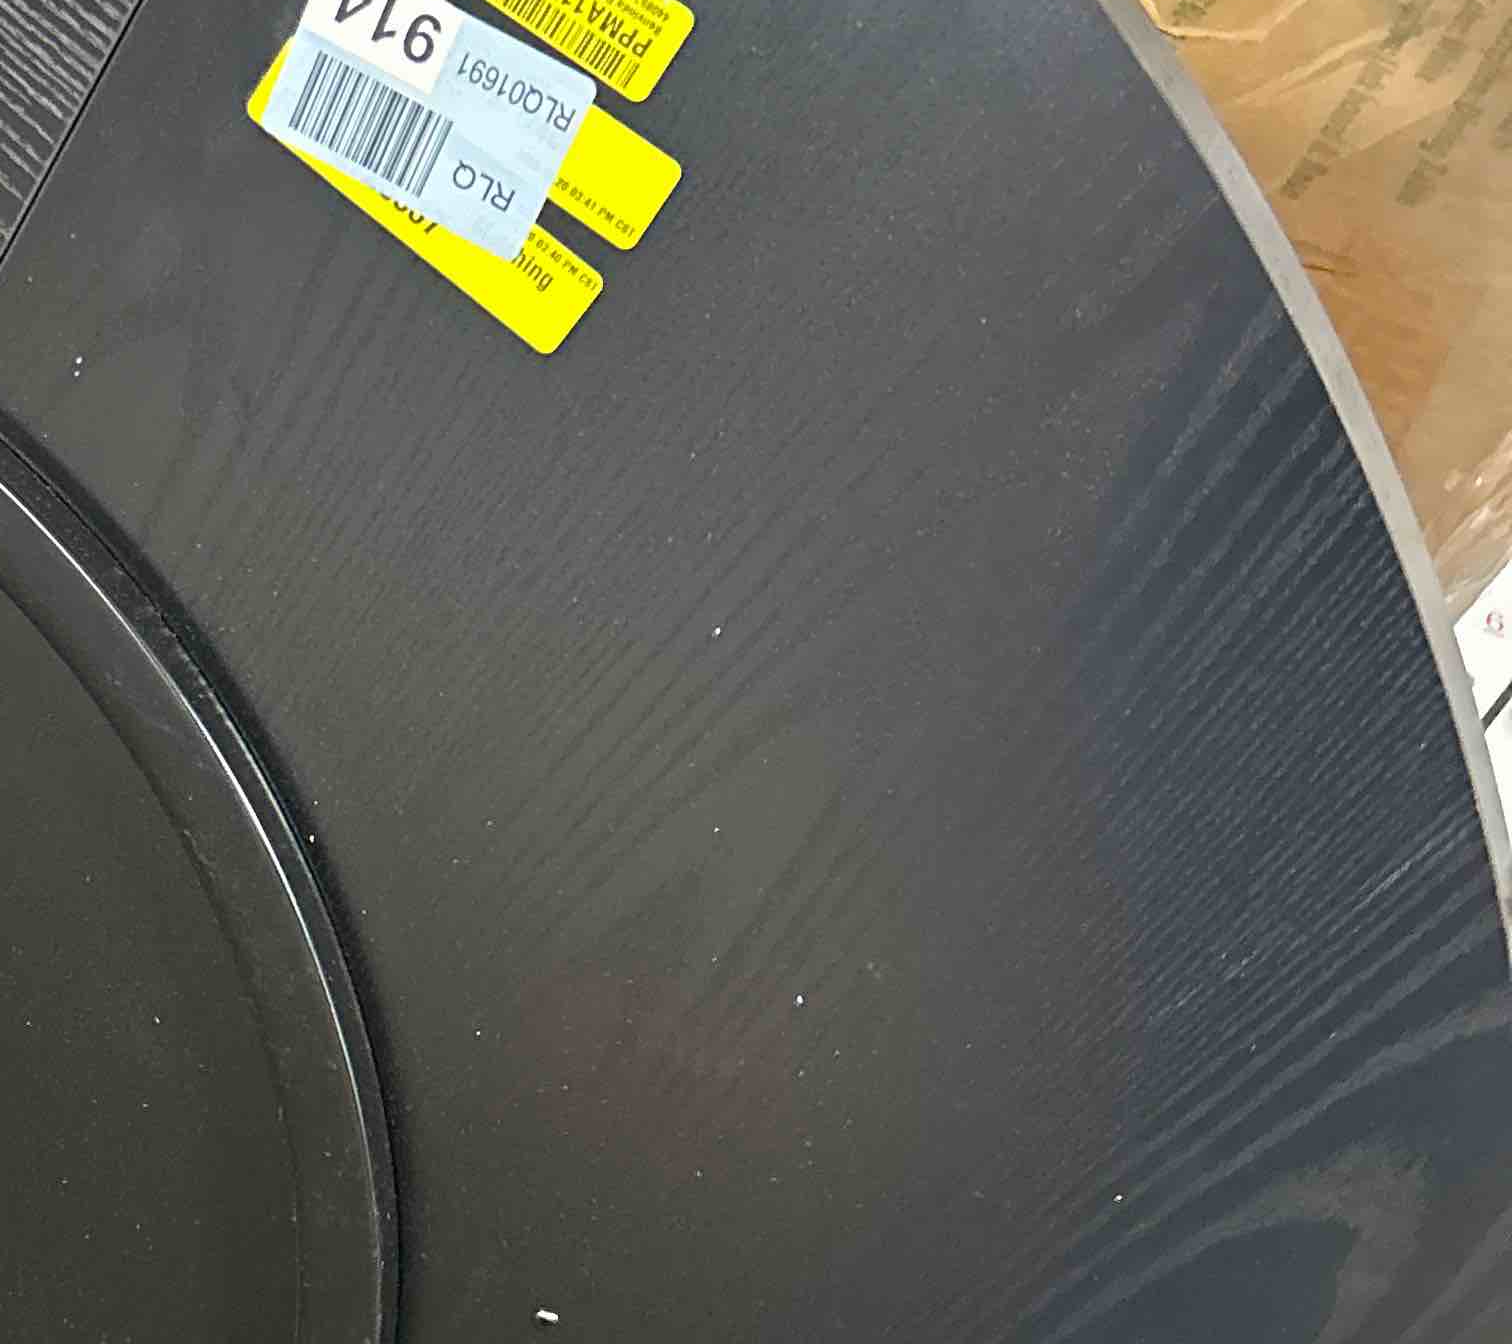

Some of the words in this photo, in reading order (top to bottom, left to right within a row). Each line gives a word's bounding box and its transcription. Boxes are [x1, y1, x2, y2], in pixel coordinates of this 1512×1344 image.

[457, 52, 576, 132] RLQ01691
[453, 160, 515, 212] RLQ
[597, 208, 615, 223] PM
[615, 219, 635, 237] CST
[562, 260, 579, 275] PM
[579, 273, 598, 291] CST
